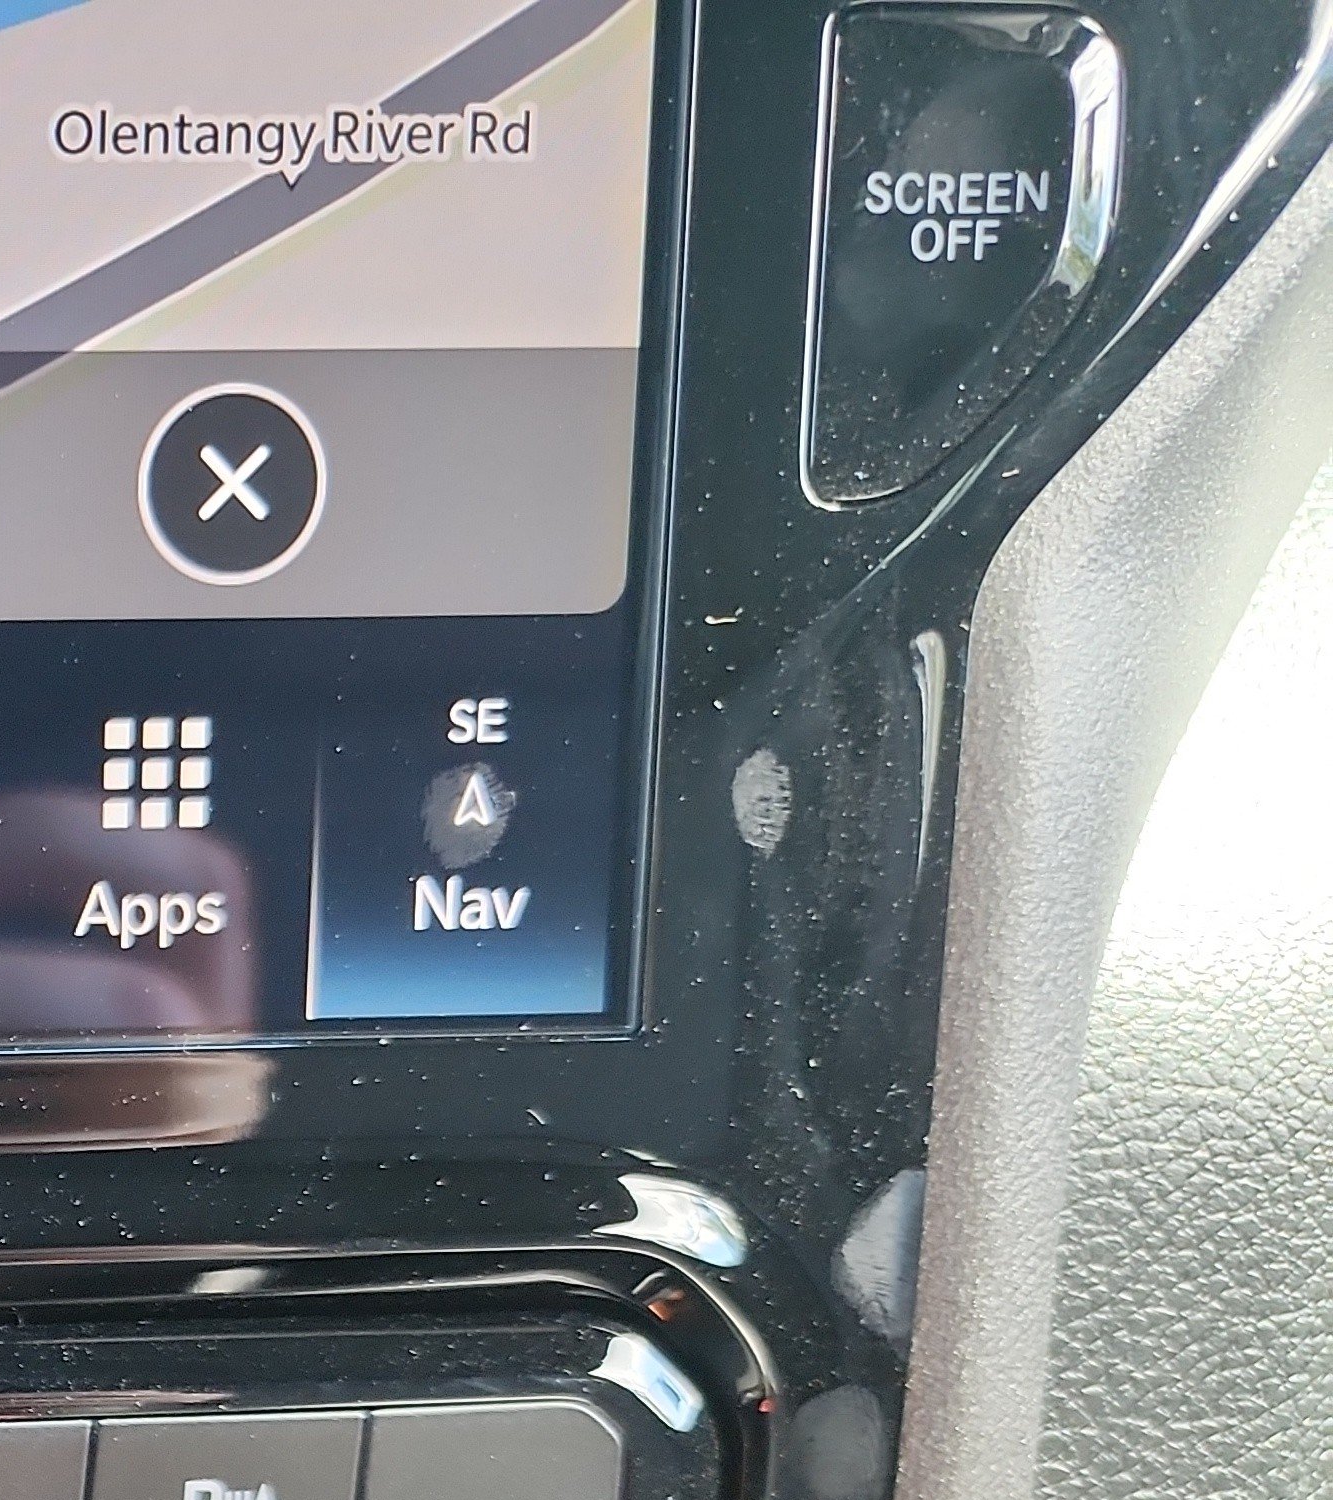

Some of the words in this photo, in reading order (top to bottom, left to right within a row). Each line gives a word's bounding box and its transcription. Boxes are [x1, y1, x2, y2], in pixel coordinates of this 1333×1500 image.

[54, 109, 317, 165] Olentangy
[331, 108, 455, 156] River
[469, 108, 531, 155] Rd
[864, 170, 1049, 215] SCREEN
[910, 218, 1001, 262] OFF
[447, 697, 509, 744] SE
[73, 880, 228, 949] Apps
[413, 874, 532, 931] Nav
